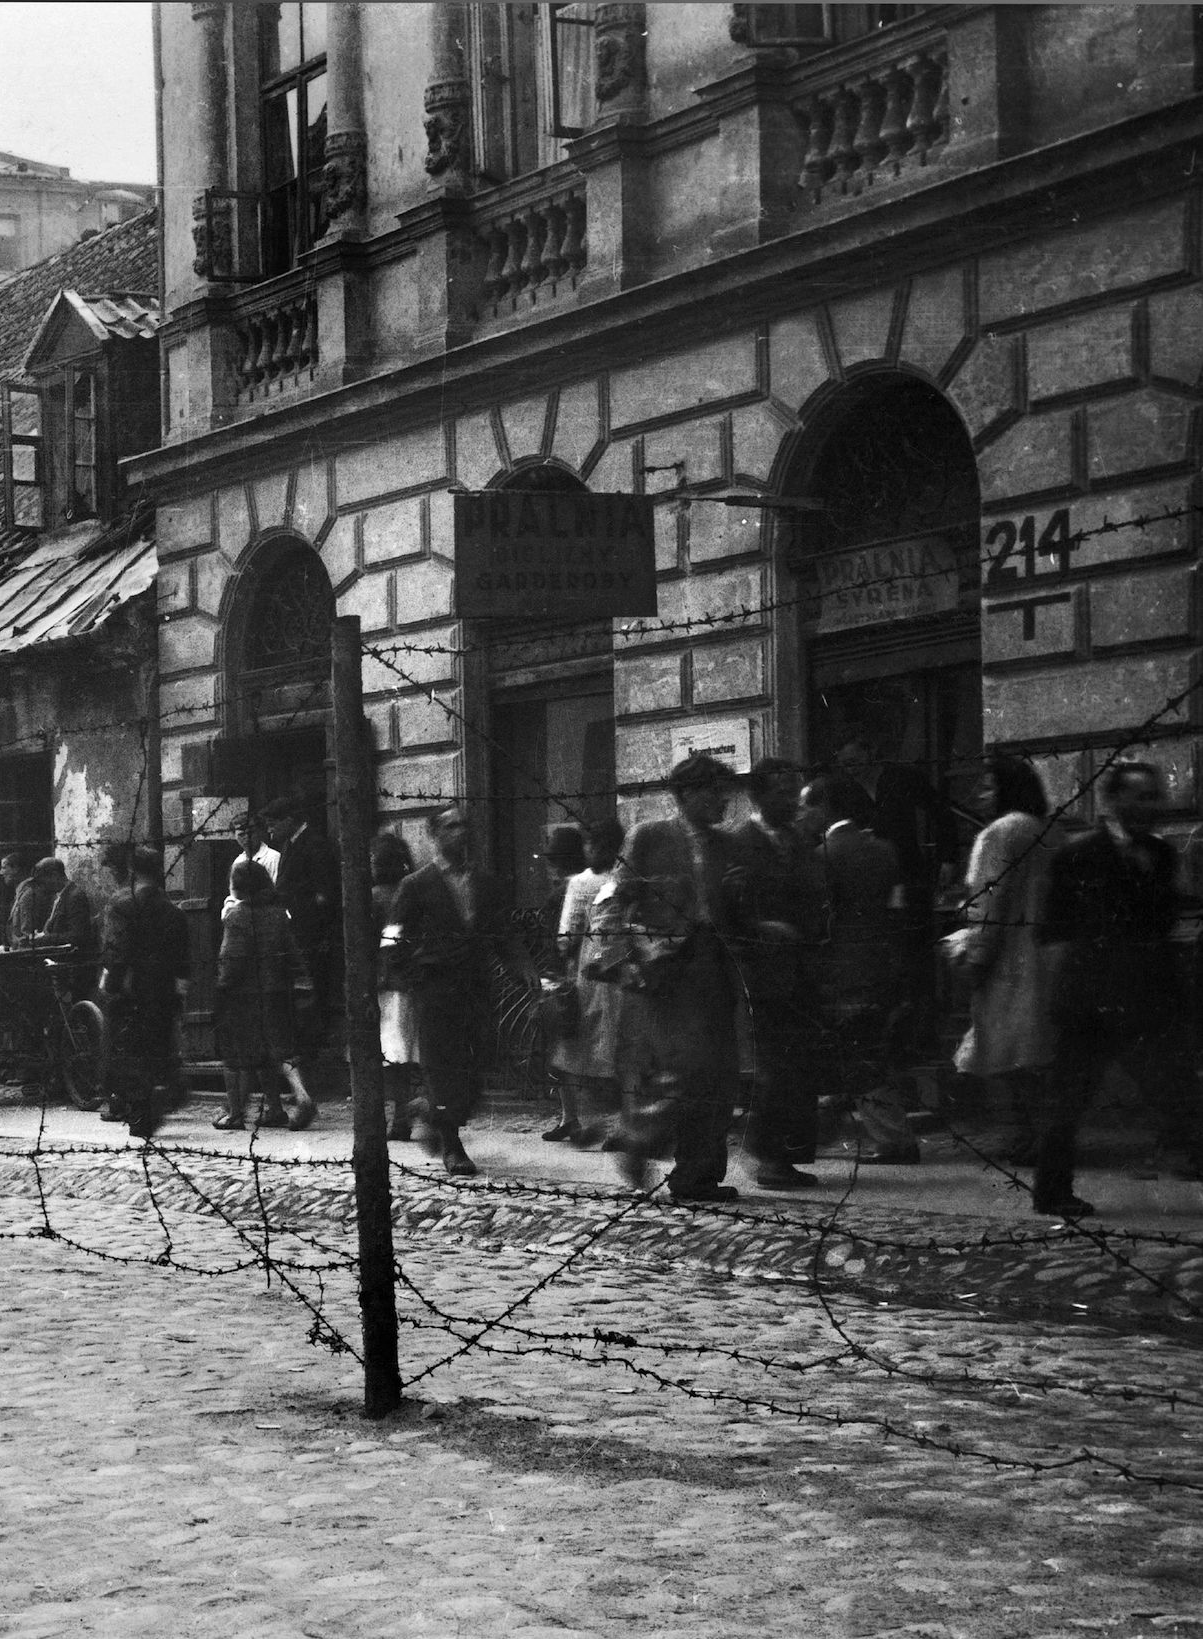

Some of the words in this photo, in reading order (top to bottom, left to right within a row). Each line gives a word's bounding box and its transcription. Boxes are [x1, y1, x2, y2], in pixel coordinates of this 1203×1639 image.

[464, 494, 646, 538] PRALNIA
[821, 544, 942, 586] PRALNIA
[985, 509, 1077, 586] 214
[476, 572, 633, 591] GARDEROBY
[836, 580, 934, 609] SYRENA
[986, 591, 1072, 641] T
